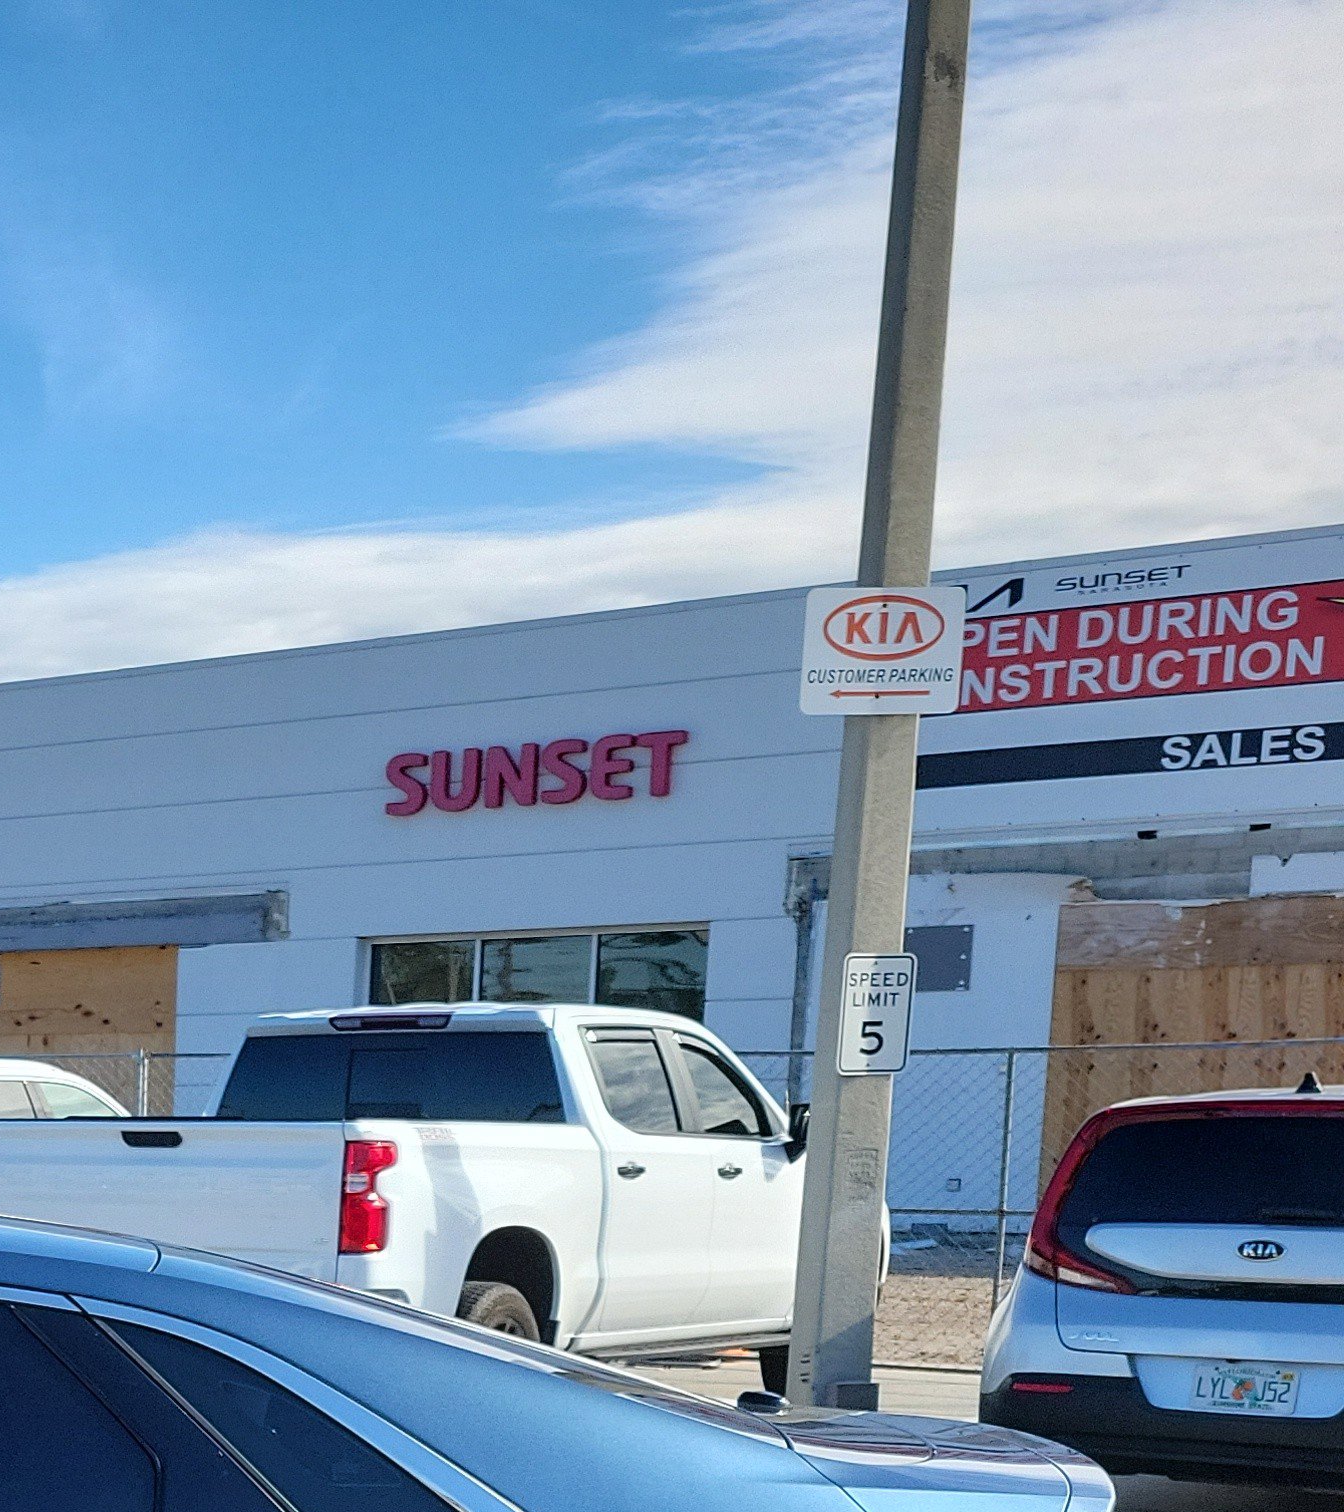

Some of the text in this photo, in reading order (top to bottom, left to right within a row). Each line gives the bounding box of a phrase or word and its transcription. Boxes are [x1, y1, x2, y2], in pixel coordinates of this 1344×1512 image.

[1054, 564, 1192, 592] SUNSET
[845, 612, 924, 645] KIA
[963, 614, 1059, 659] PEN
[1076, 590, 1300, 650] DURING
[807, 667, 954, 684] CUSTOMER PARKING
[960, 635, 1326, 707] NSTRUCTION
[1160, 725, 1326, 771] SALES
[385, 729, 690, 817] SUNSET
[848, 972, 910, 988] SPEED
[852, 991, 901, 1008] LIMIT
[859, 1020, 884, 1056] 5
[1243, 1243, 1279, 1258] KIA
[1196, 1376, 1230, 1399] LYL
